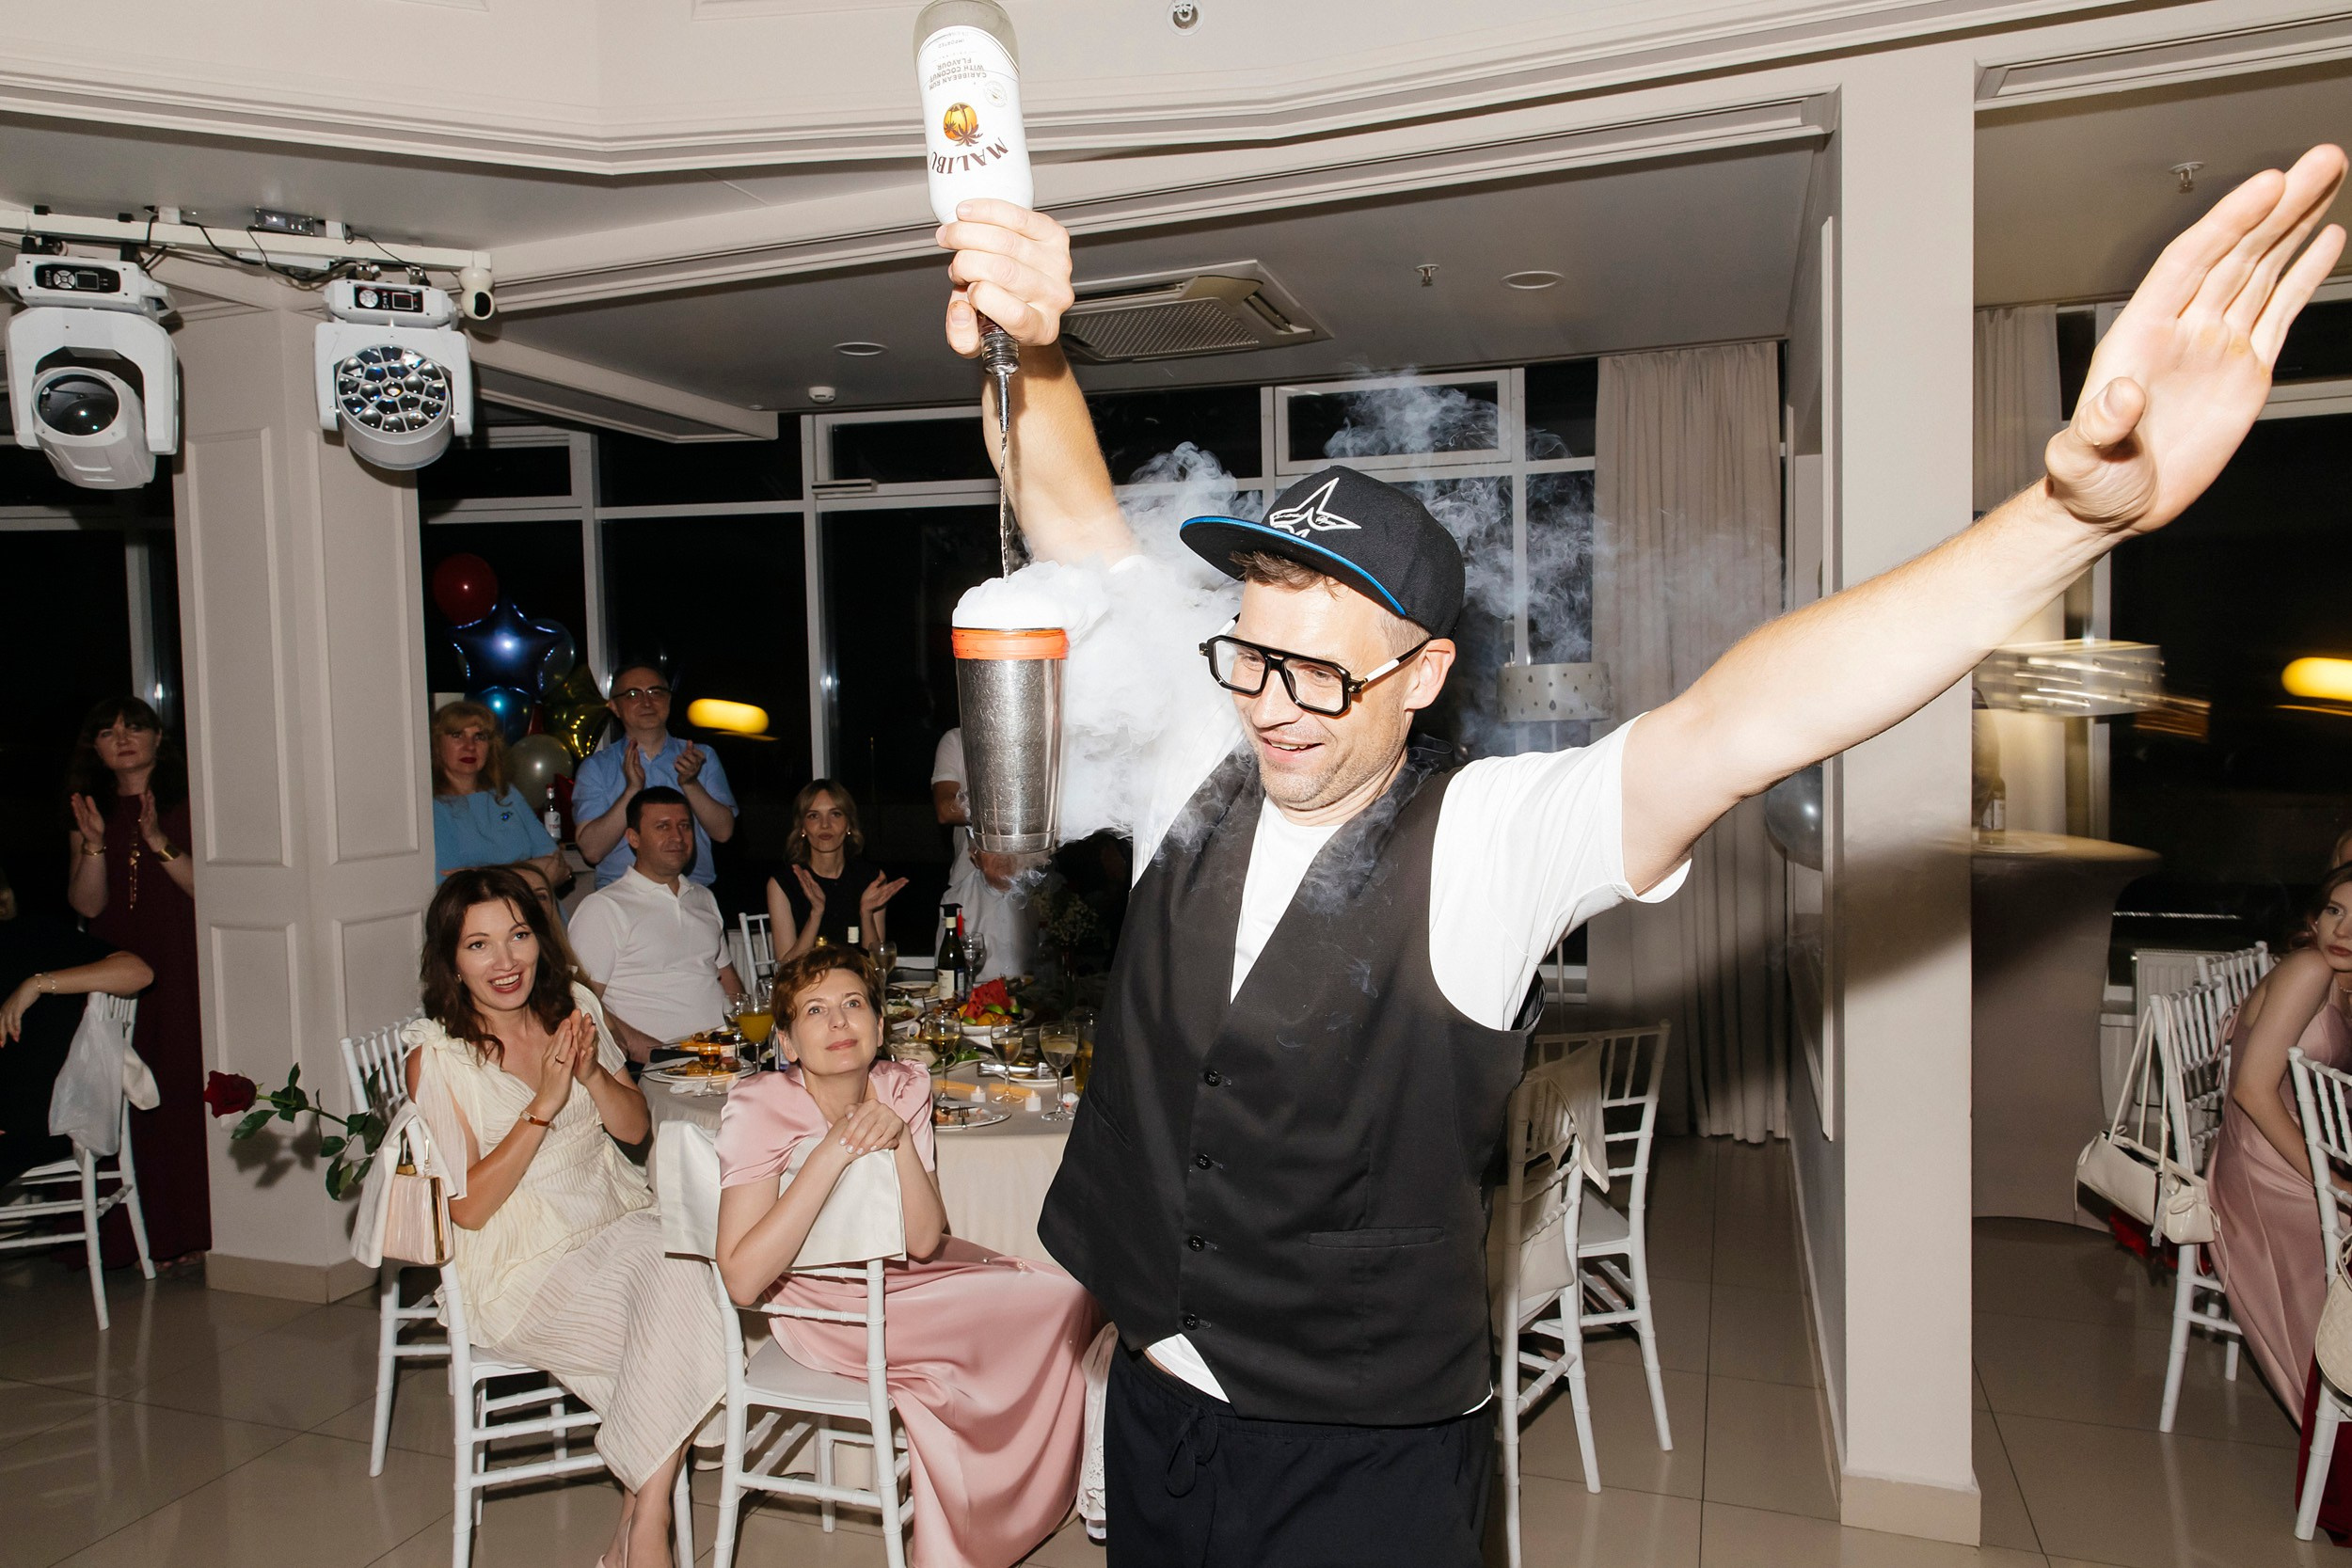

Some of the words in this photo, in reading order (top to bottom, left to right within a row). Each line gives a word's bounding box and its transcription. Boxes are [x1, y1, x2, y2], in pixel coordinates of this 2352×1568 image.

[937, 57, 972, 70] FLAVOUR
[930, 66, 961, 83] COCONUT
[942, 71, 987, 83] CARIBBEAN
[929, 80, 941, 90] RUM
[930, 136, 1009, 174] MALIBU
